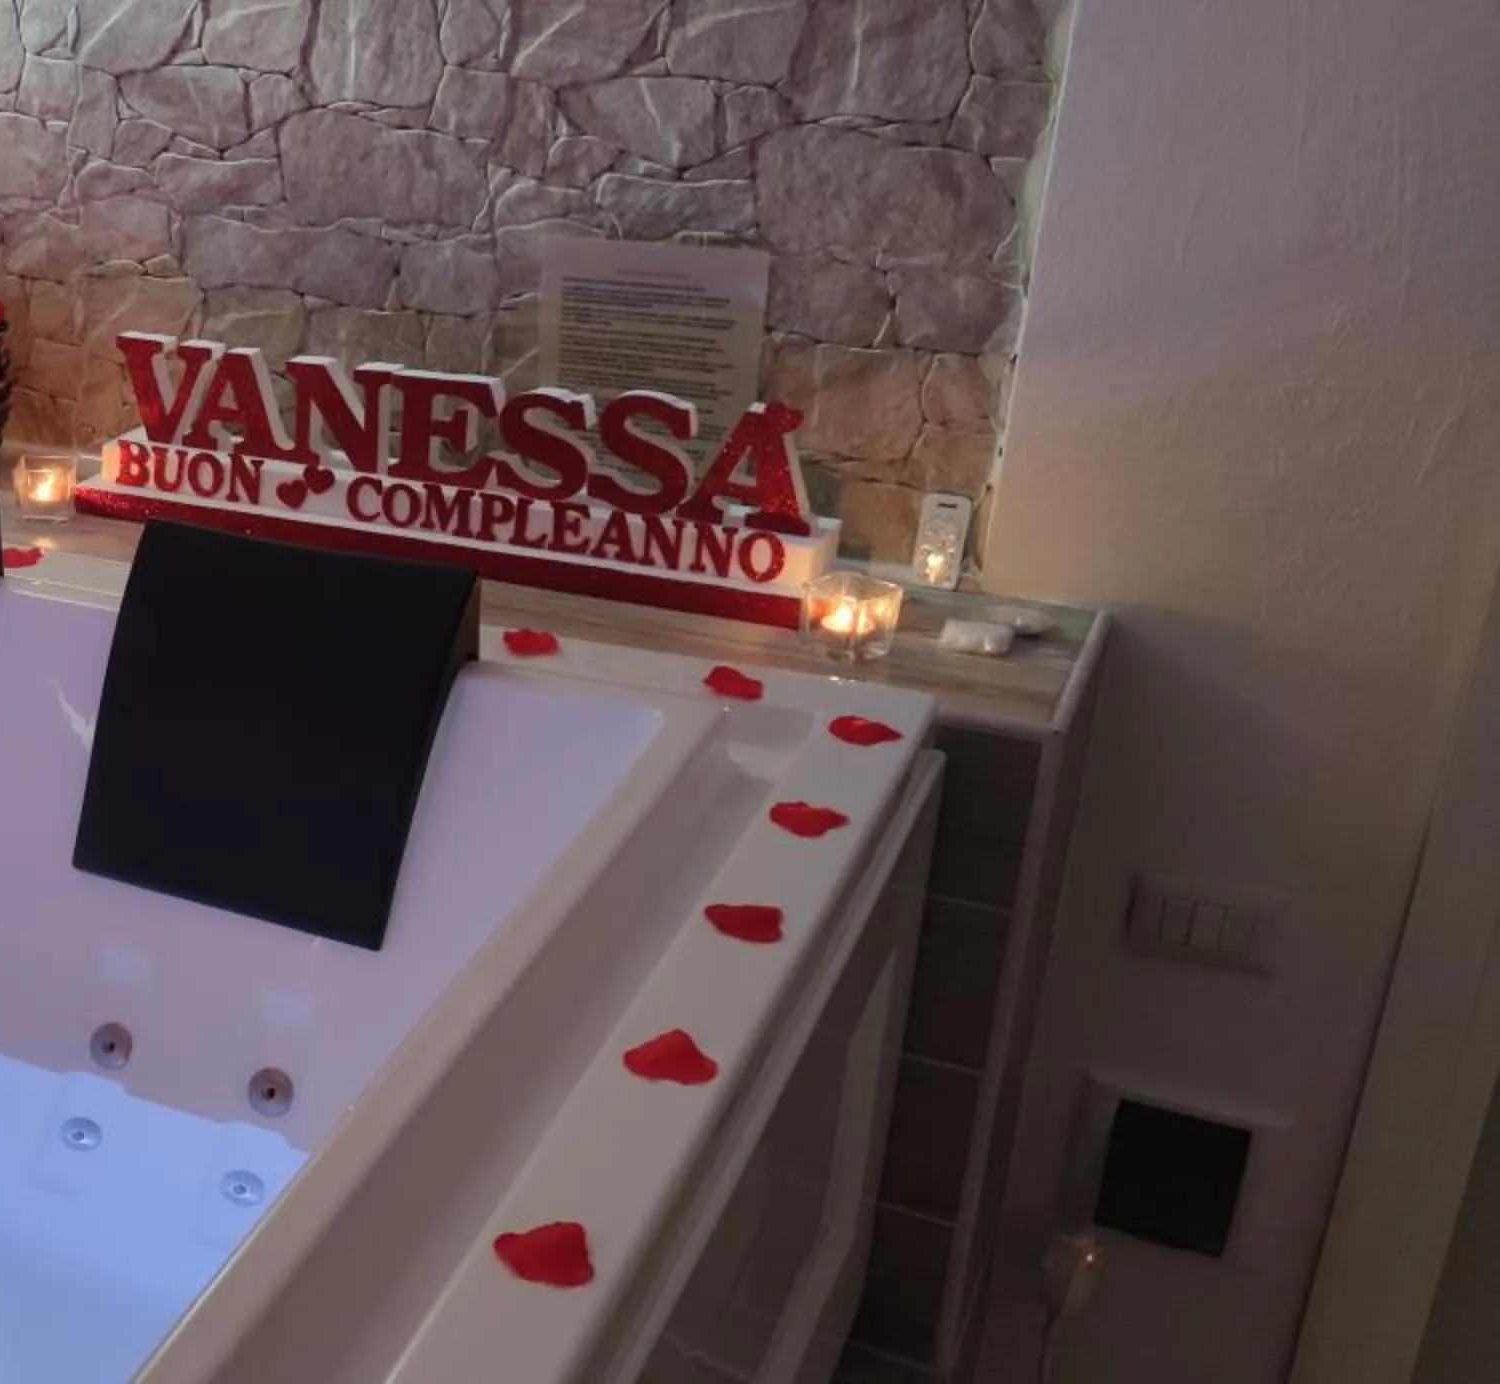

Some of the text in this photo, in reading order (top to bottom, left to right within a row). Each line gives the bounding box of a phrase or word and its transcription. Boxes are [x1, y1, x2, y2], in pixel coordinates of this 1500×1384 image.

[116, 332, 814, 536] VANESSA
[116, 439, 787, 584] BUON COMPLEANNO
